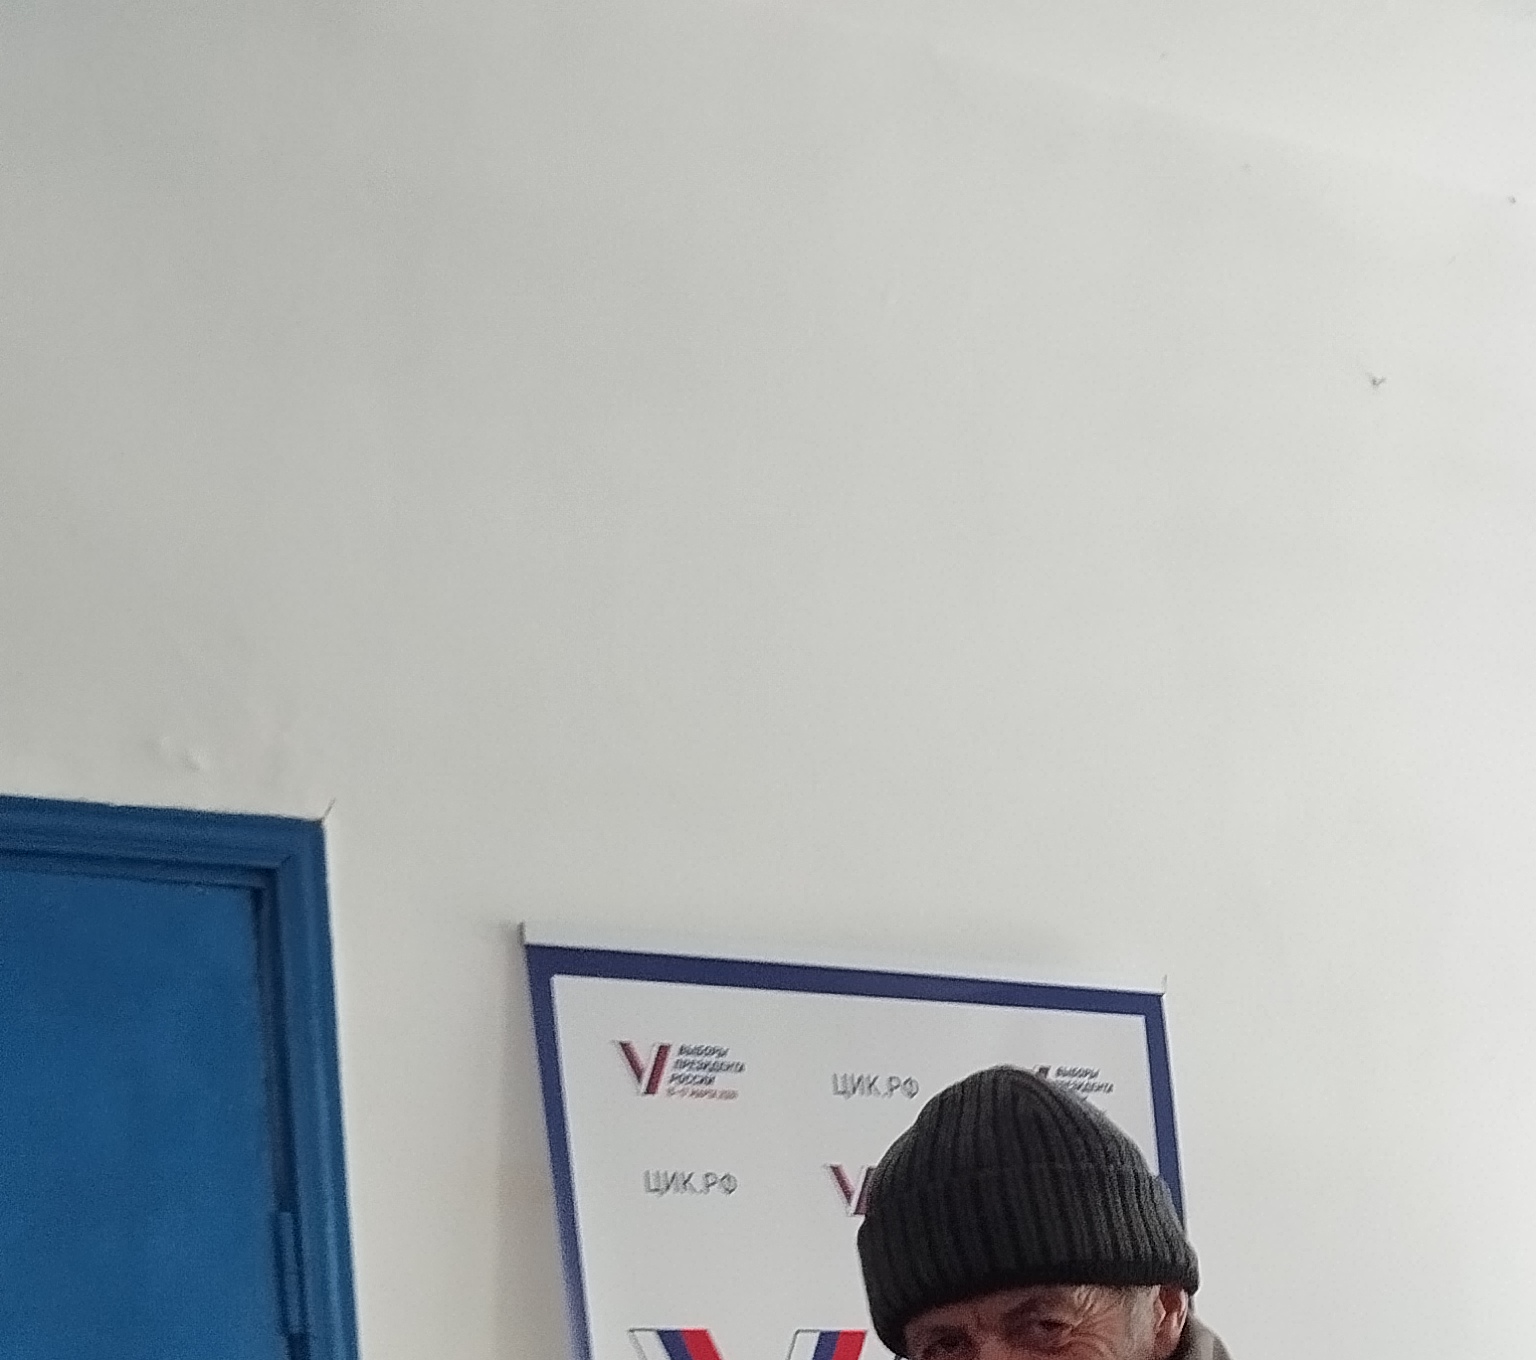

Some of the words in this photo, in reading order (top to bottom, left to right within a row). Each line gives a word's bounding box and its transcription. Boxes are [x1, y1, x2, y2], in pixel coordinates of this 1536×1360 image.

[678, 1044, 730, 1058] ВЫБОРЫ
[832, 1072, 919, 1100] ЦИК.РФ
[643, 1169, 738, 1198] ЦИК.РФ
